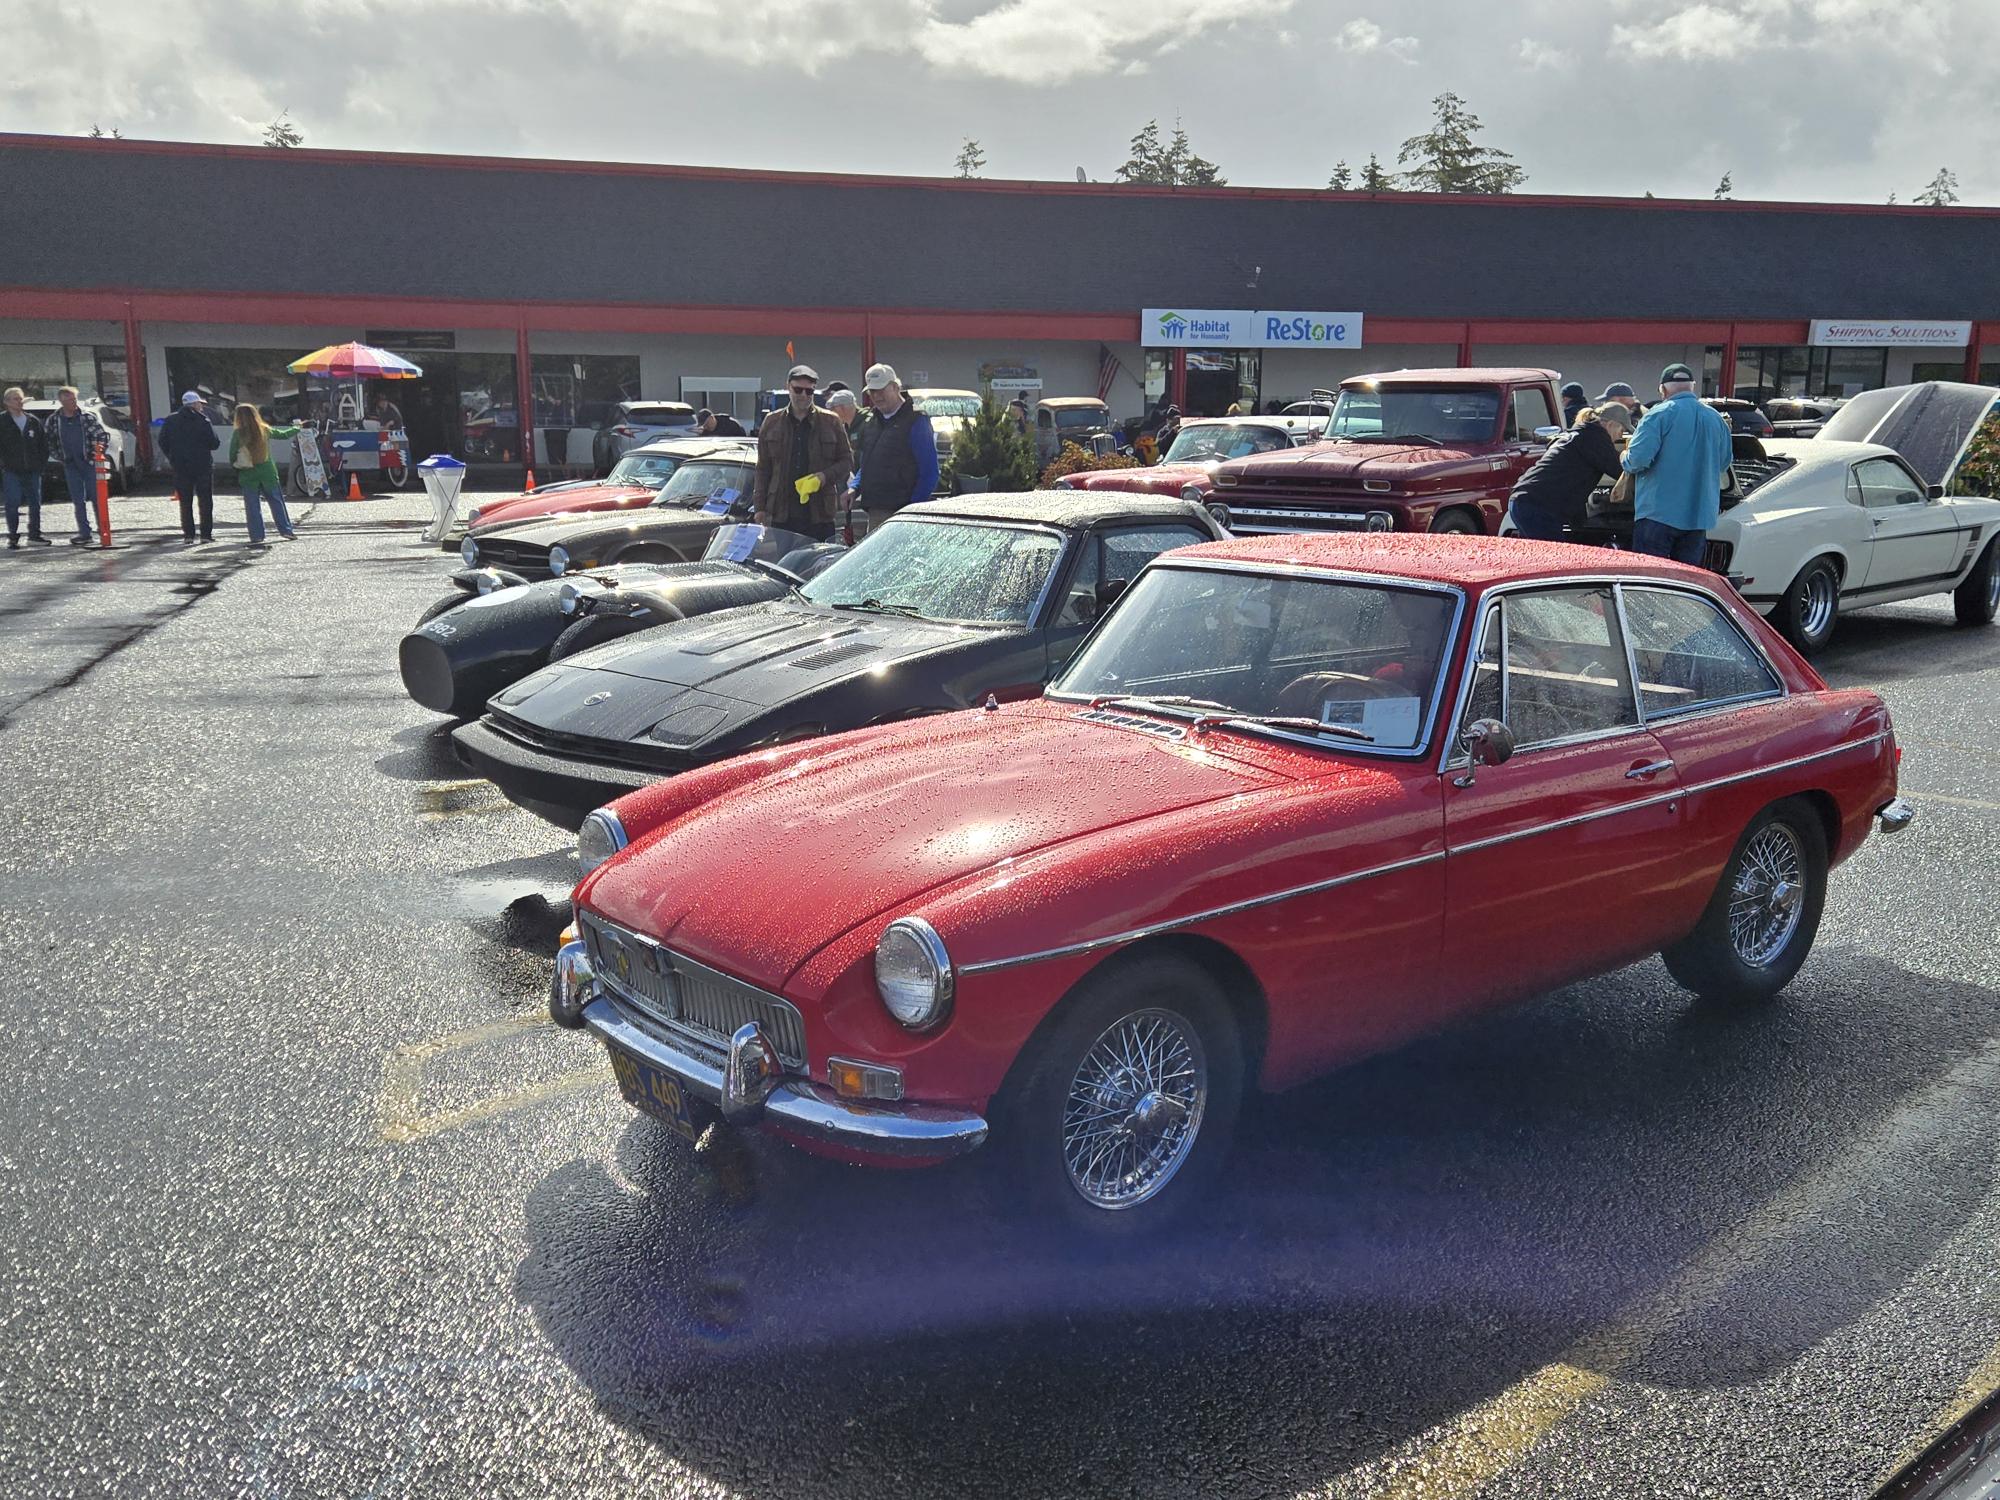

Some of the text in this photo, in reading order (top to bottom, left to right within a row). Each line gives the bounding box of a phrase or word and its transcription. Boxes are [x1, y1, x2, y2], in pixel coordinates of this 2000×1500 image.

[1190, 320, 1230, 332] Habitat
[1266, 317, 1346, 341] ReStore
[1825, 325, 1959, 338] SHIPPING SOLUTIONS
[1201, 333, 1230, 341] Humanity
[1241, 509, 1351, 519] CHEVROLET
[650, 1072, 681, 1116] 449
